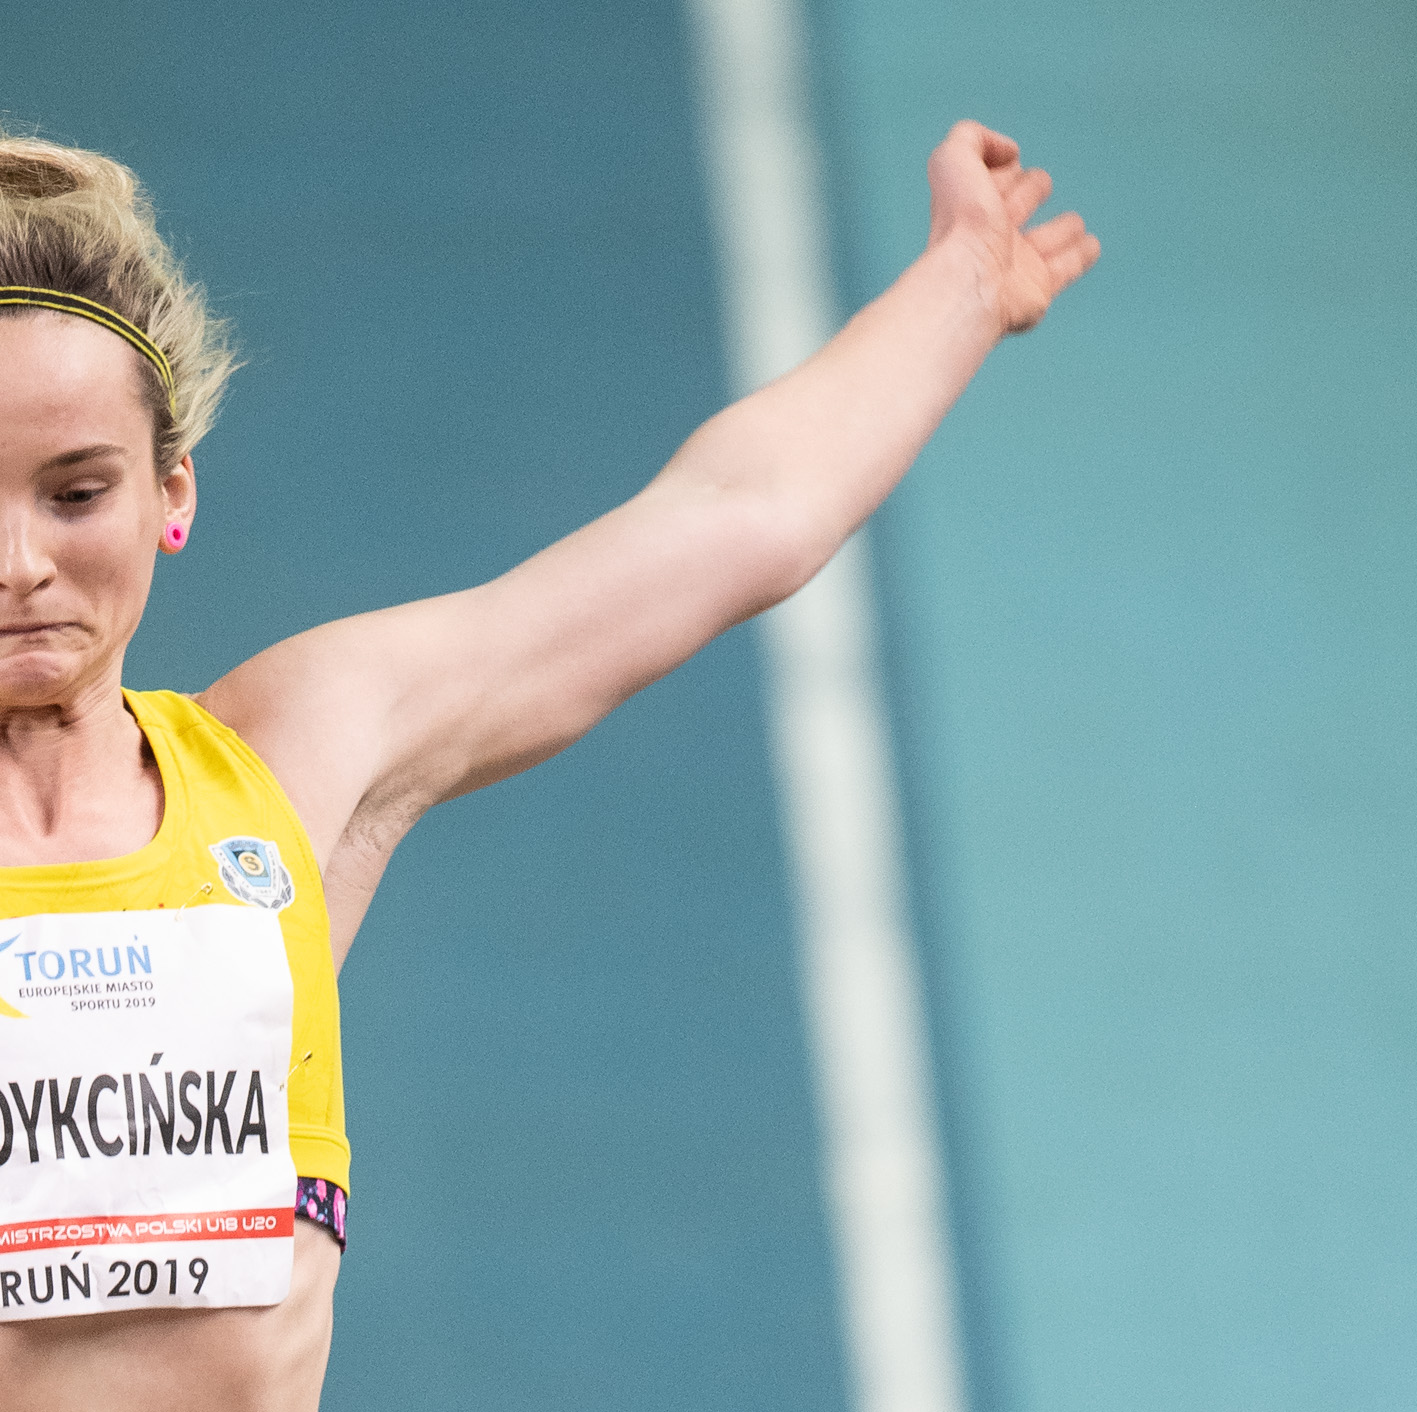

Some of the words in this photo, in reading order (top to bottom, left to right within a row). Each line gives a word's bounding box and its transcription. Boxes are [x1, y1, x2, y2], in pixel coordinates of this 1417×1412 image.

[14, 934, 153, 982] TORUŃ
[18, 982, 102, 999] EUROPEJSKIE
[105, 980, 154, 994] MIASTO
[70, 998, 121, 1012] SPORTU
[125, 997, 156, 1009] 2019
[135, 1218, 202, 1236] POLSKI
[206, 1217, 239, 1233] U18
[242, 1215, 277, 1231] U20
[107, 1257, 210, 1299] 2019
